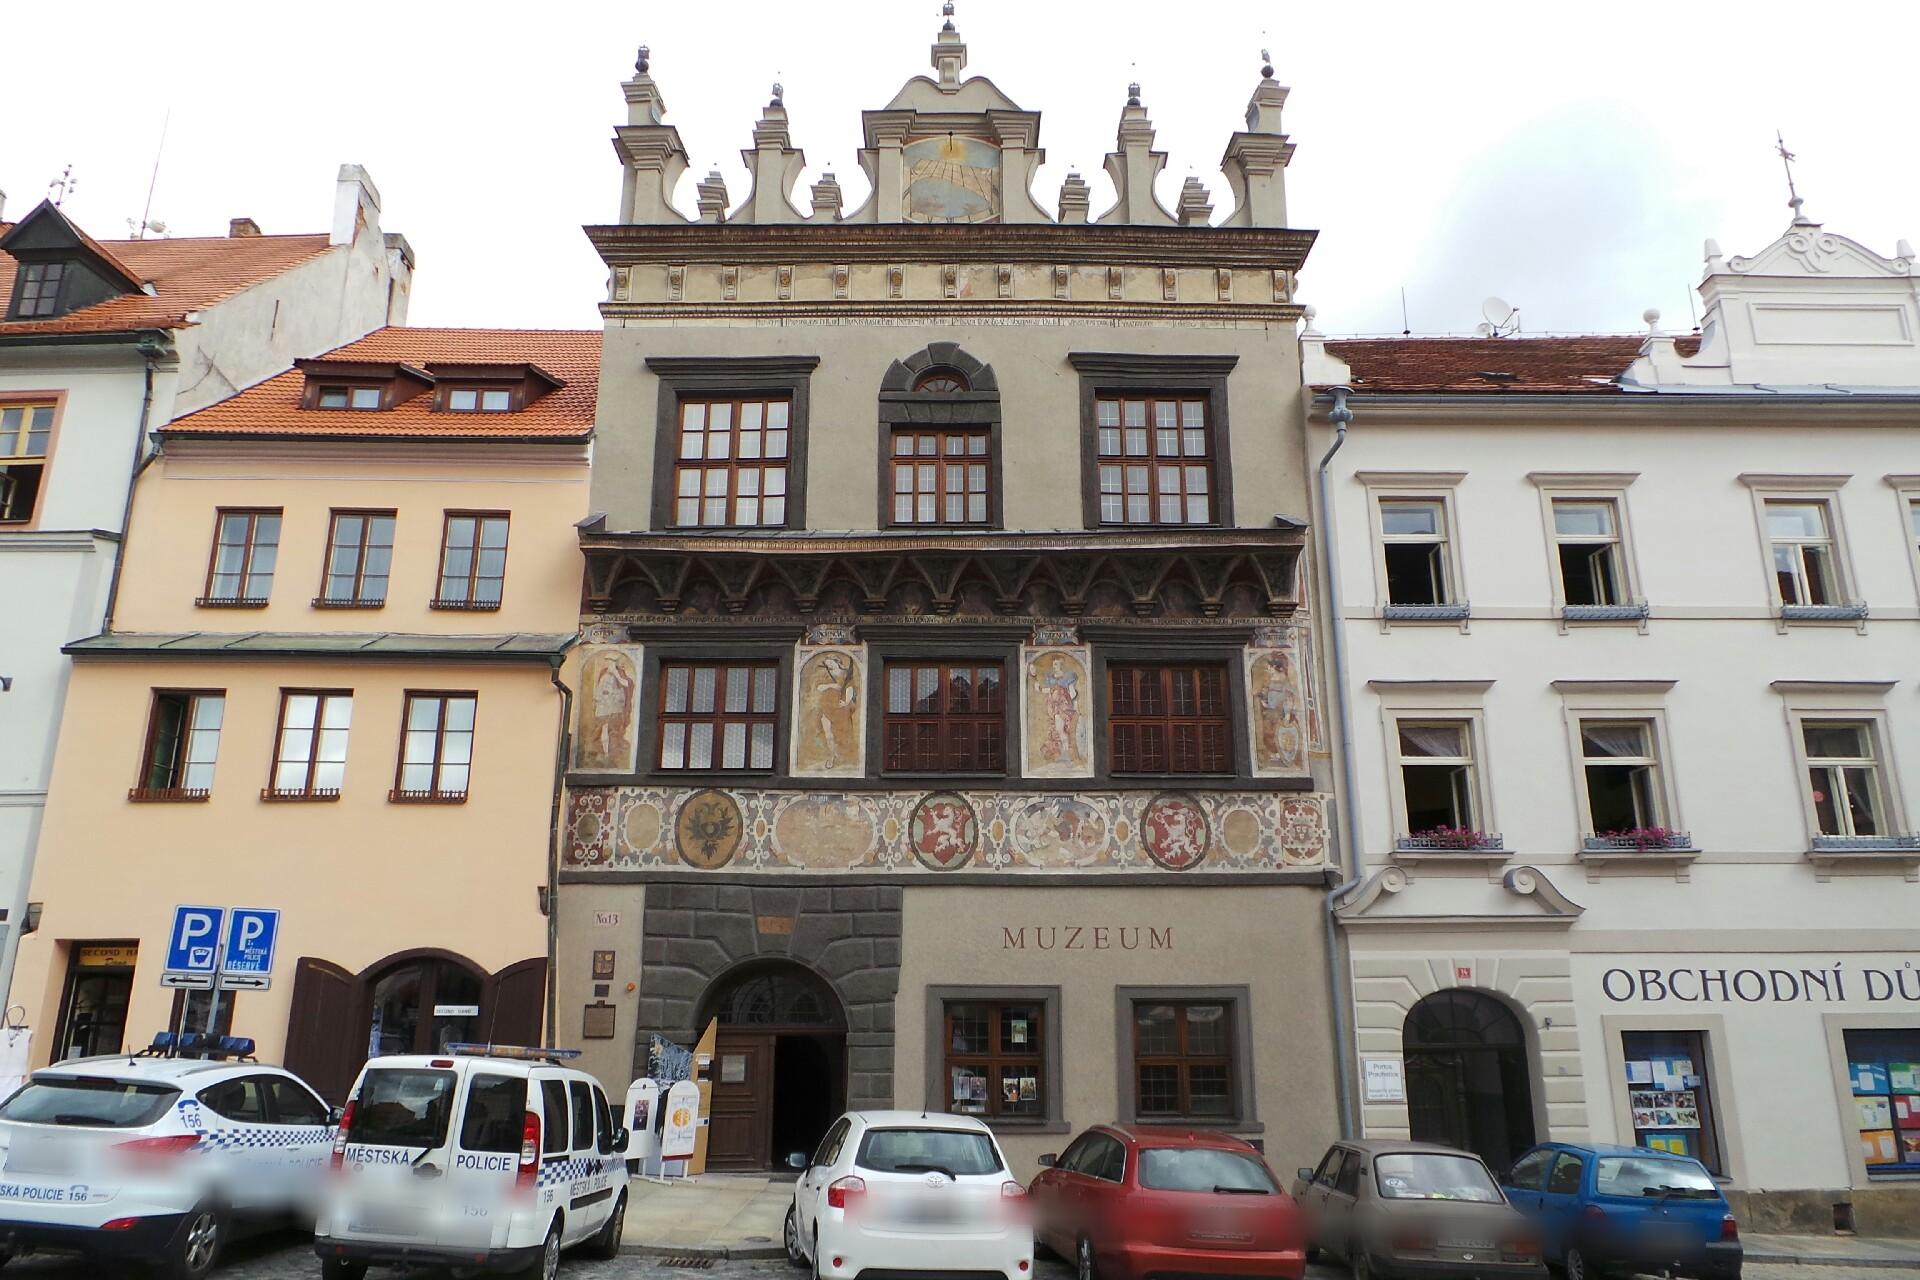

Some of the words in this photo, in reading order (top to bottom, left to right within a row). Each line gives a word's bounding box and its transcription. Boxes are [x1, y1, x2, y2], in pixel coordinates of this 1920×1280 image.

[179, 912, 212, 951] P
[238, 916, 264, 951] P
[1001, 925, 1174, 950] MUZEUM
[1602, 961, 1847, 1002] OBCHODNÍ
[180, 1113, 201, 1128] 156
[346, 1146, 409, 1165] MĚSTSKÁ
[456, 1154, 511, 1171] POLICIE
[0, 1183, 19, 1199] SKÁ
[23, 1187, 64, 1201] POLICIE
[69, 1192, 88, 1202] 156
